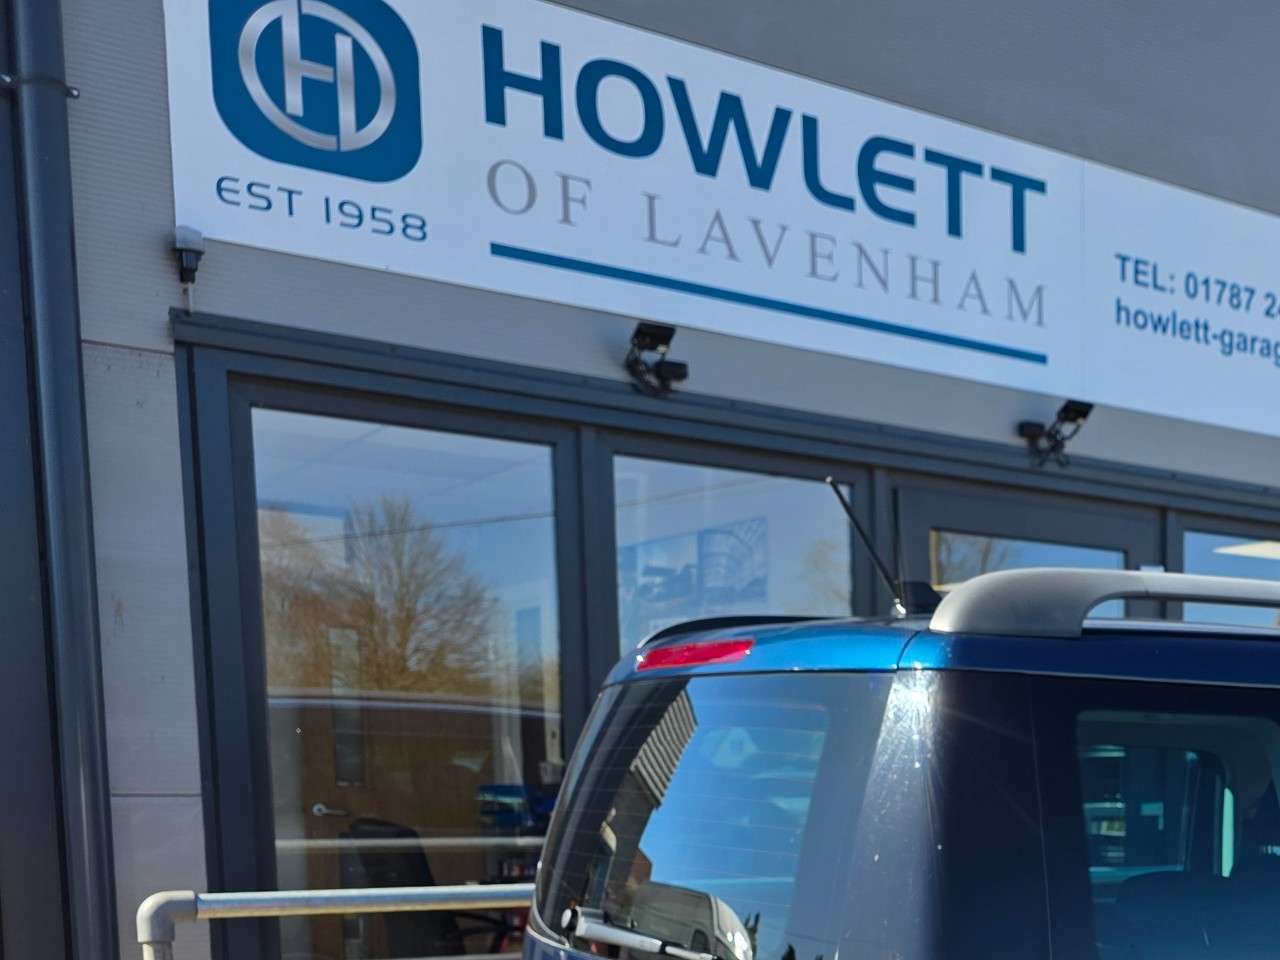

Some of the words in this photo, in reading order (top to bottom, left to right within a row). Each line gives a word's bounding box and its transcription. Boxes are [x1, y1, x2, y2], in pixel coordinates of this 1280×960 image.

[481, 23, 1048, 255] HOWLETT
[216, 175, 303, 217] EST
[324, 196, 428, 243] 1958
[486, 159, 593, 228] OF
[641, 191, 1048, 328] LAVENHAM
[1115, 254, 1176, 295] TEL:
[1184, 271, 1256, 313] 01787
